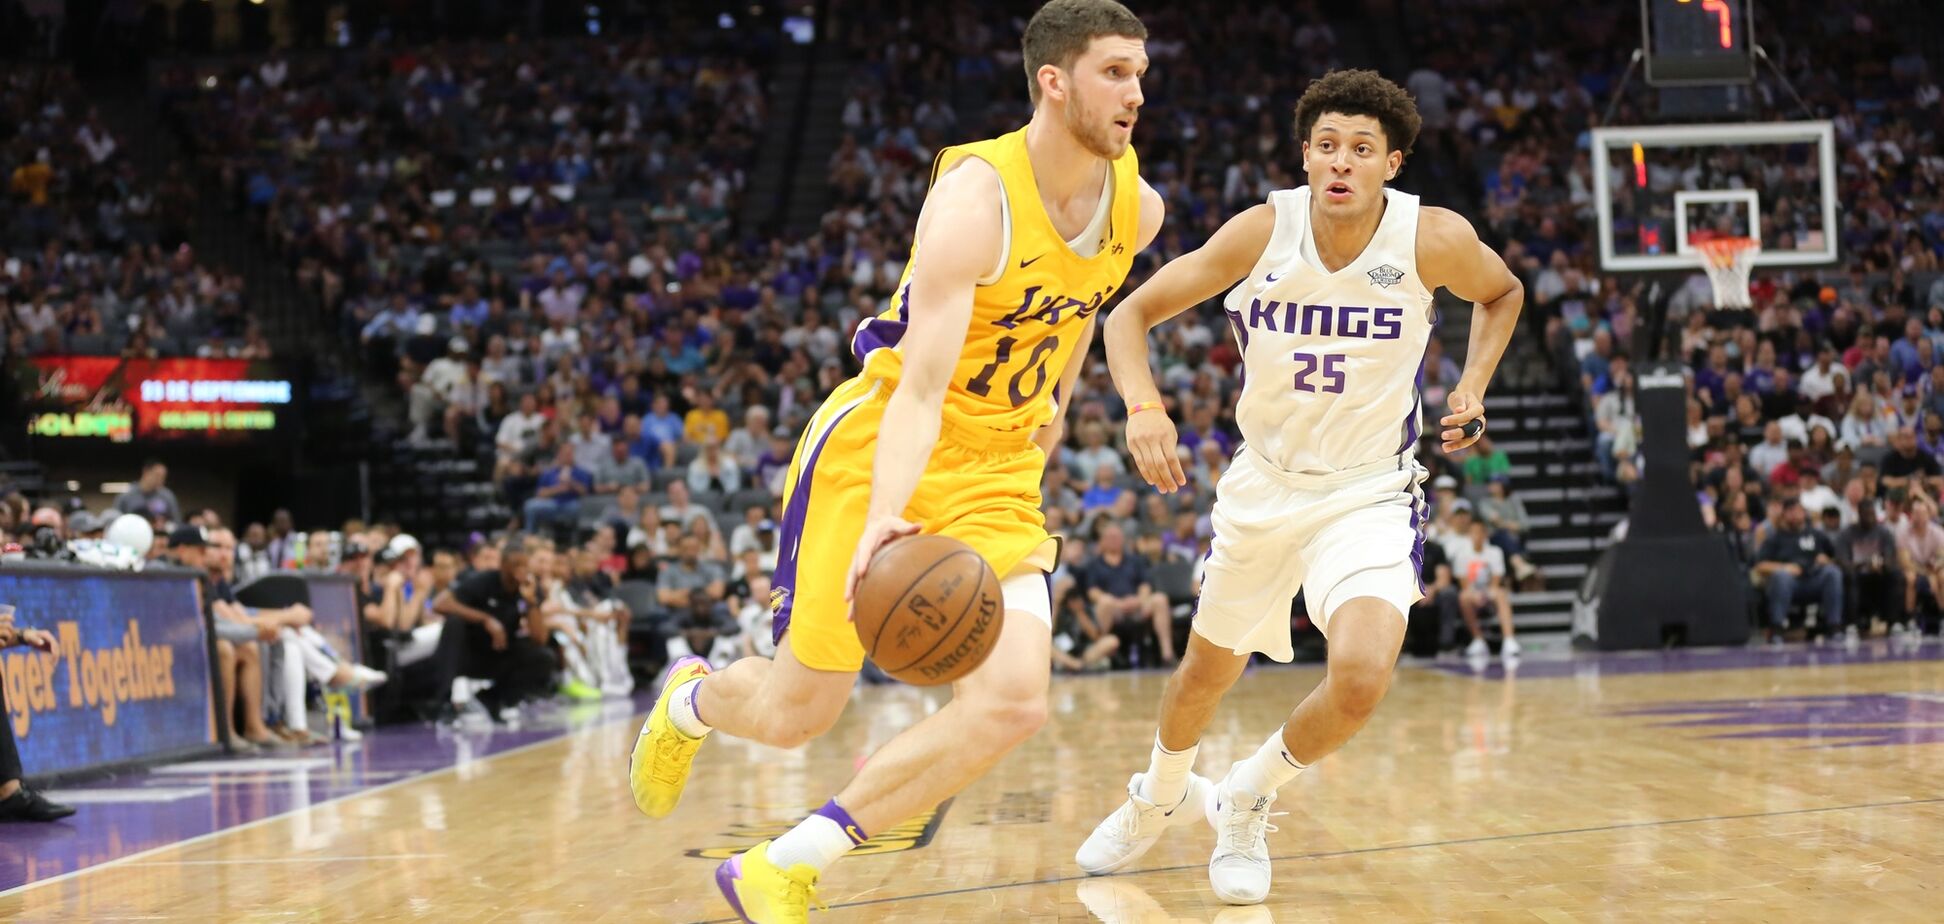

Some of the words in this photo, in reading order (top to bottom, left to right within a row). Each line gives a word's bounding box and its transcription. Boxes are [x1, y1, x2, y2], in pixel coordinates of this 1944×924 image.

[1702, 2, 1732, 48] 7
[1249, 297, 1404, 340] KINGS
[966, 336, 1059, 408] 10
[1293, 352, 1346, 395] 25
[917, 592, 997, 680] SPALDING
[58, 617, 175, 727] Together
